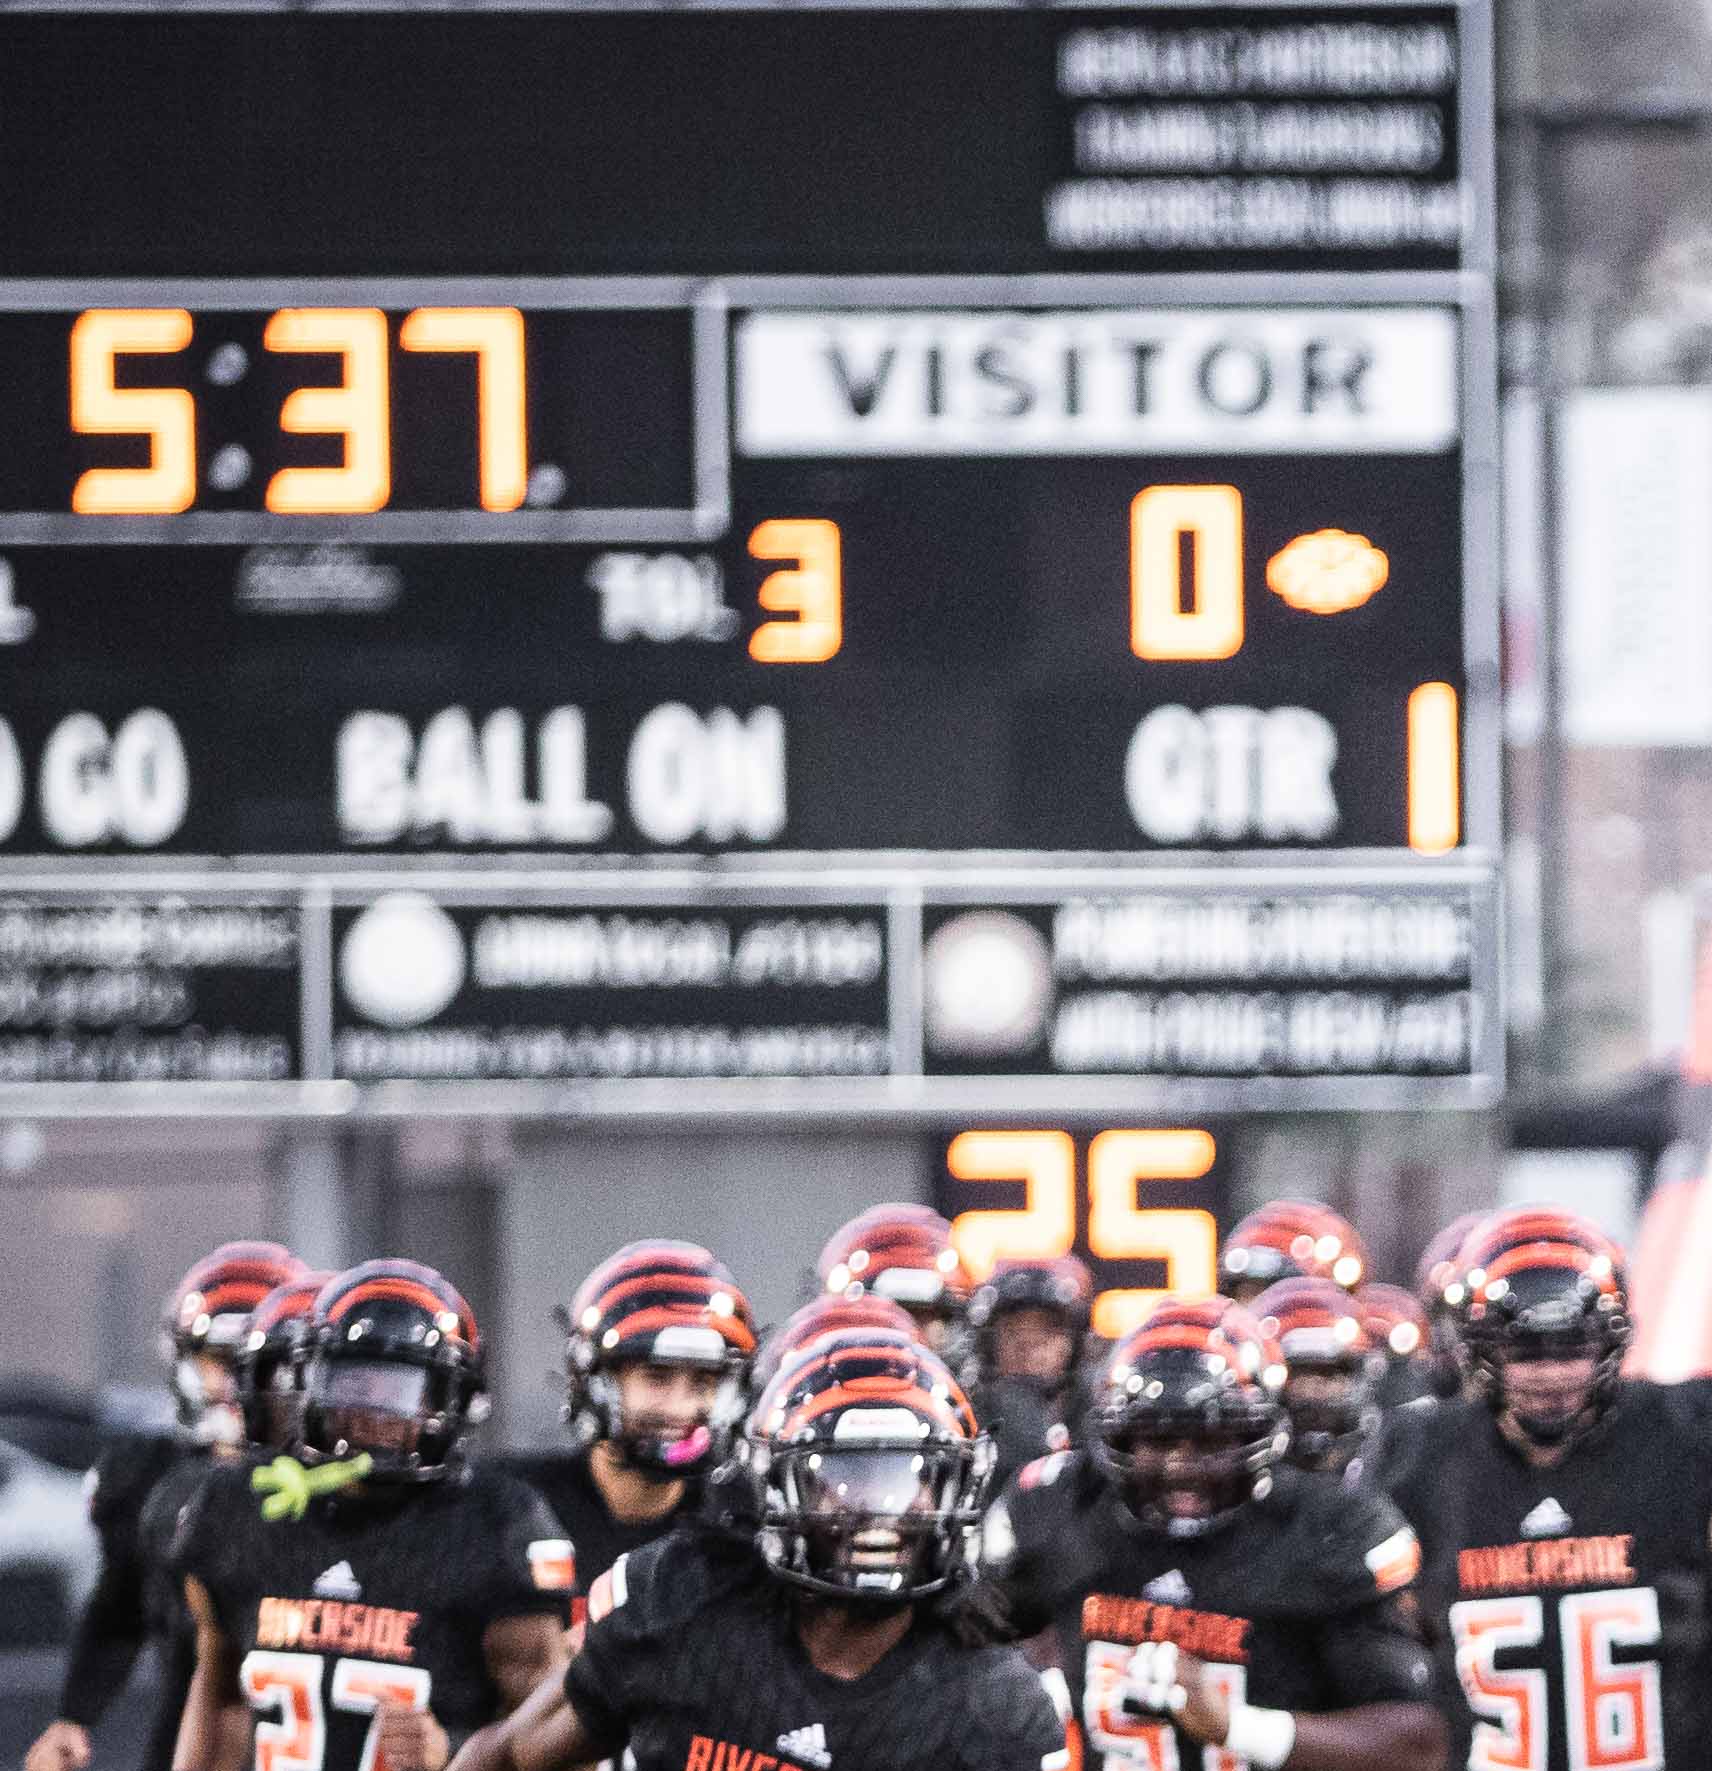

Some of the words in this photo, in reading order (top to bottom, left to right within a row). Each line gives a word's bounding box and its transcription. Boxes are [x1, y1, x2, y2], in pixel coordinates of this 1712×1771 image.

[70, 305, 528, 515] 5:37
[826, 338, 1374, 418] VISITOR
[747, 518, 843, 663] 3
[1129, 483, 1245, 661] 0
[40, 706, 190, 847] GO
[335, 703, 613, 845] BALL
[626, 701, 787, 845] ON
[1406, 680, 1460, 856] 1
[946, 1129, 1218, 1339] 25
